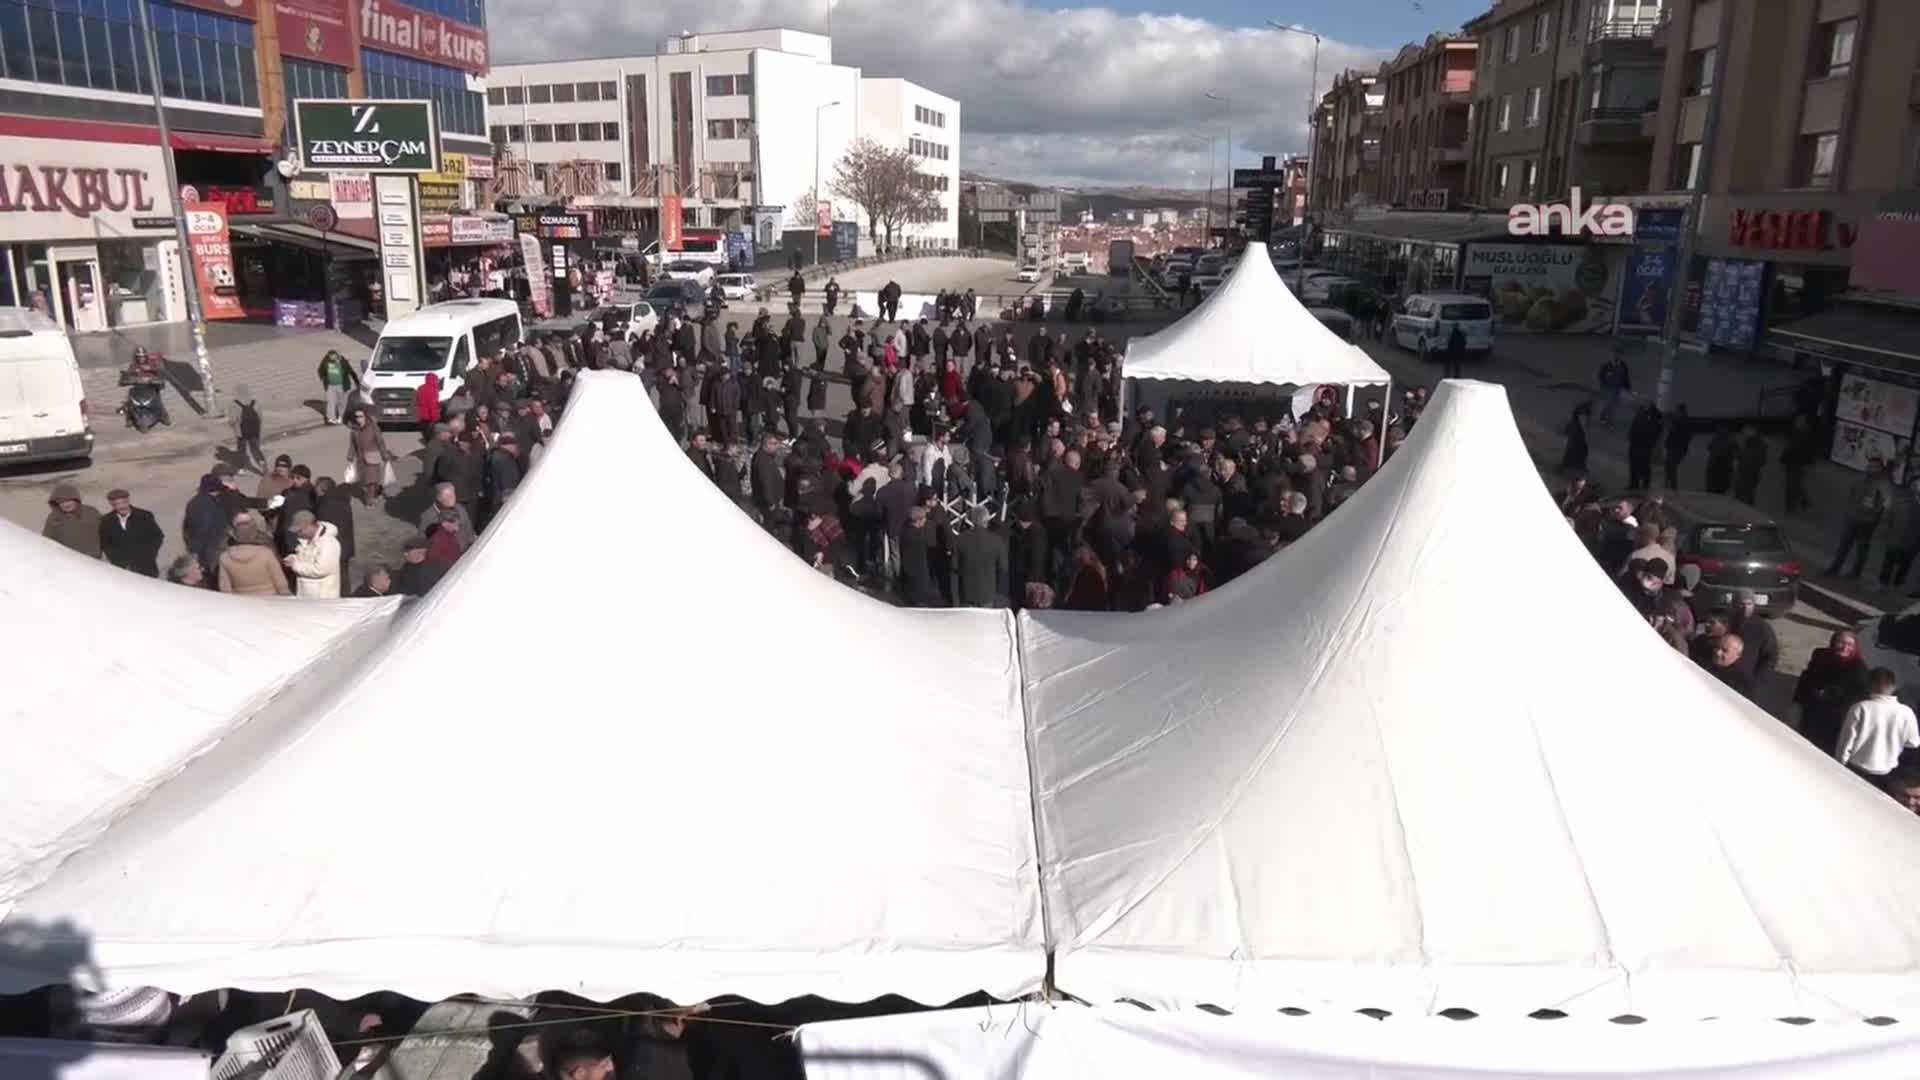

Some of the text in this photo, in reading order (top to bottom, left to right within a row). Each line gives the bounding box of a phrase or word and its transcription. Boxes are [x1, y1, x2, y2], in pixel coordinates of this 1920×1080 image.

[361, 0, 420, 50] final
[440, 20, 486, 65] kurs
[310, 140, 380, 154] ZEYNEP
[195, 243, 230, 256] BURS
